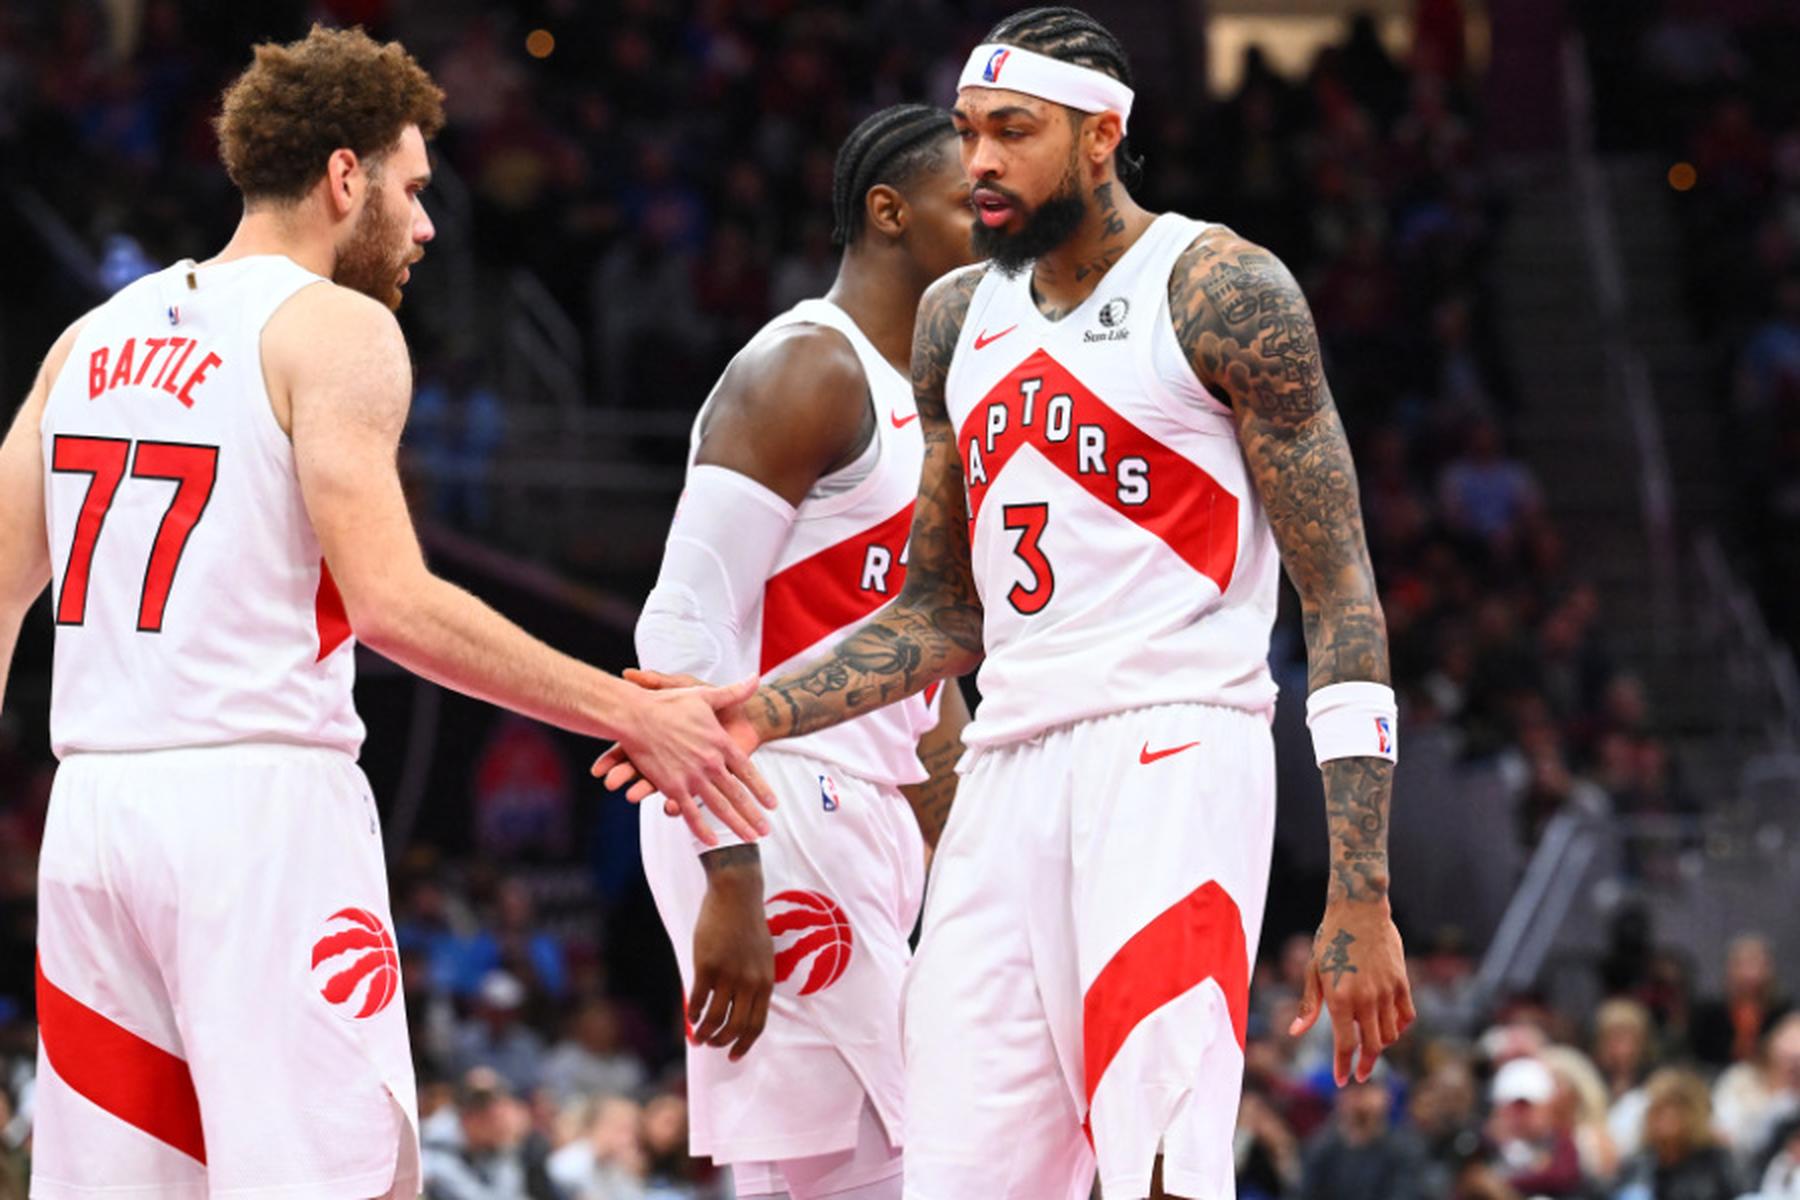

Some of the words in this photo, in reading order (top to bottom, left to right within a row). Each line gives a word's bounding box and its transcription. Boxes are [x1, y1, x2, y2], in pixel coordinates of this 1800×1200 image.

[88, 336, 223, 409] BATTLE
[1083, 329, 1107, 343] Sun
[1107, 327, 1130, 341] Life
[964, 376, 1150, 520] APTORS
[51, 433, 220, 634] 77
[1002, 502, 1056, 616] 3
